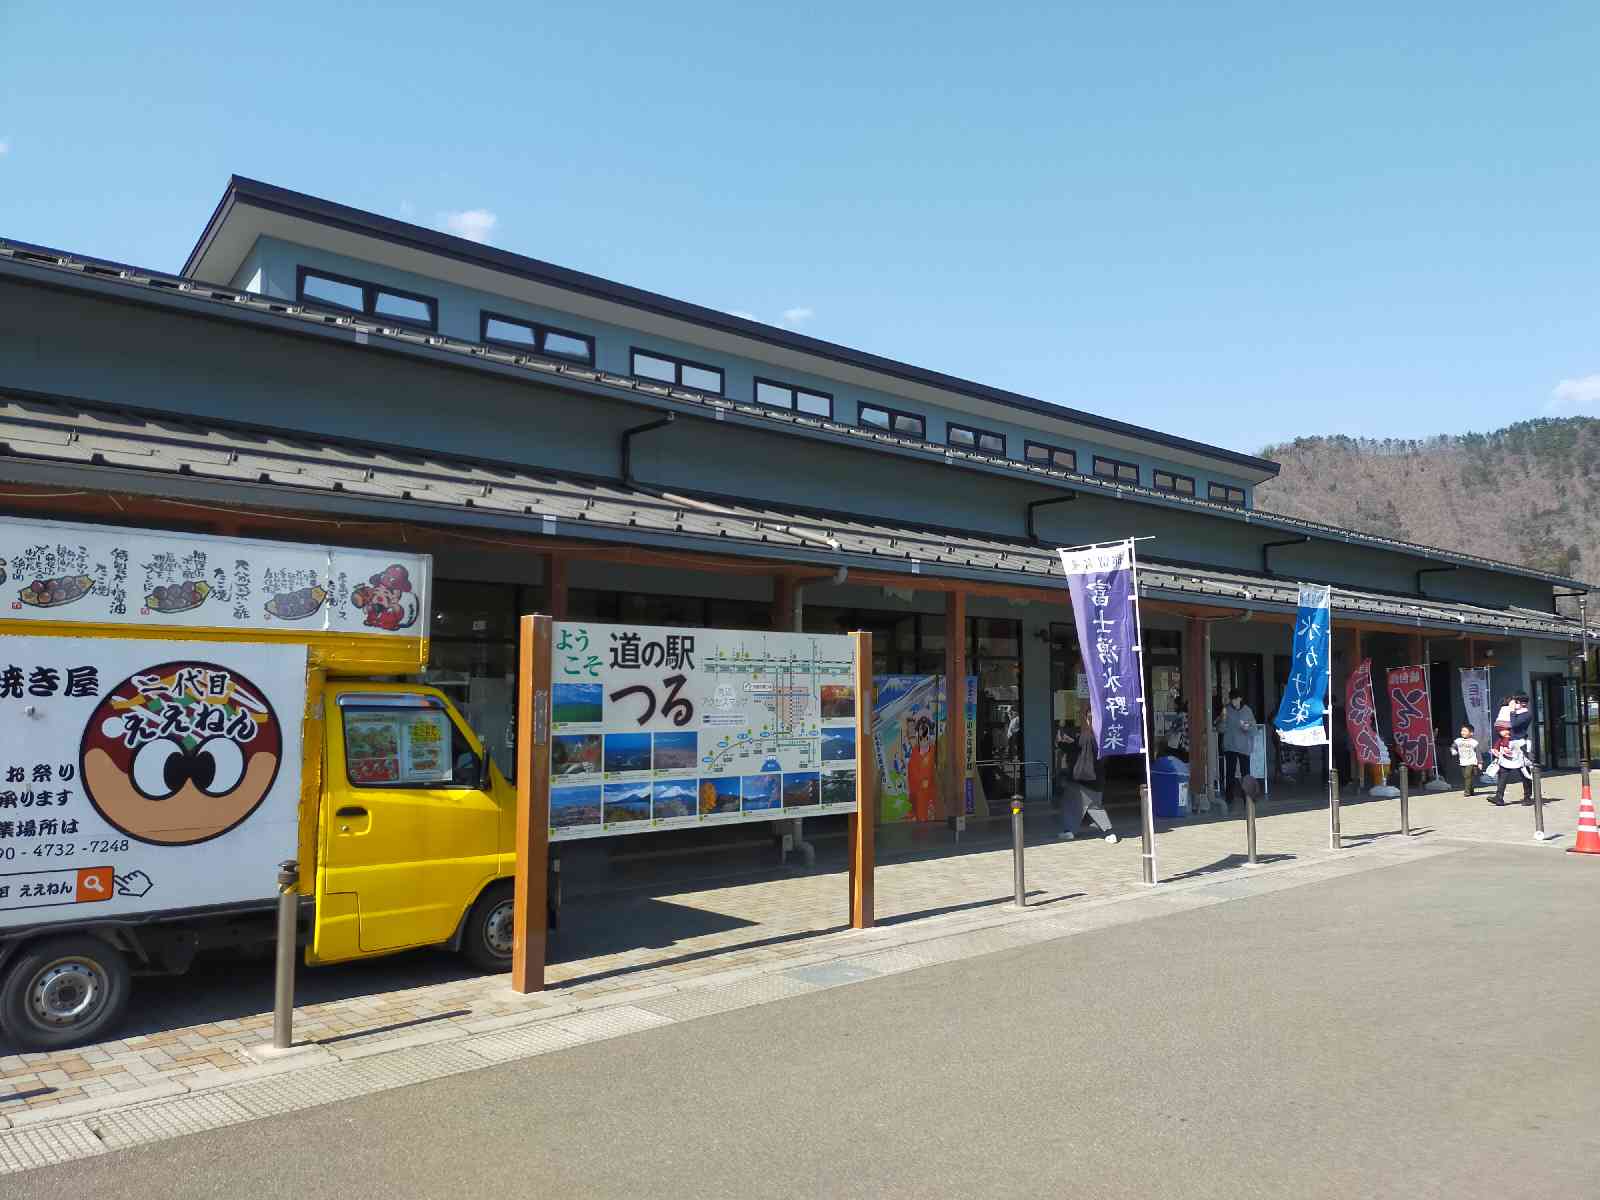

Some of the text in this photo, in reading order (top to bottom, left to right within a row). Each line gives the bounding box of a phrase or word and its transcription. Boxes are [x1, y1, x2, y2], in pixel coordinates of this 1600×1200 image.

[556, 629, 589, 651] よう
[609, 632, 695, 670] 道の駅
[564, 655, 603, 677] こそ
[138, 669, 229, 697] 二代目
[609, 673, 694, 727] つる
[122, 703, 258, 746] ええねん
[19, 881, 73, 898] ええねん
